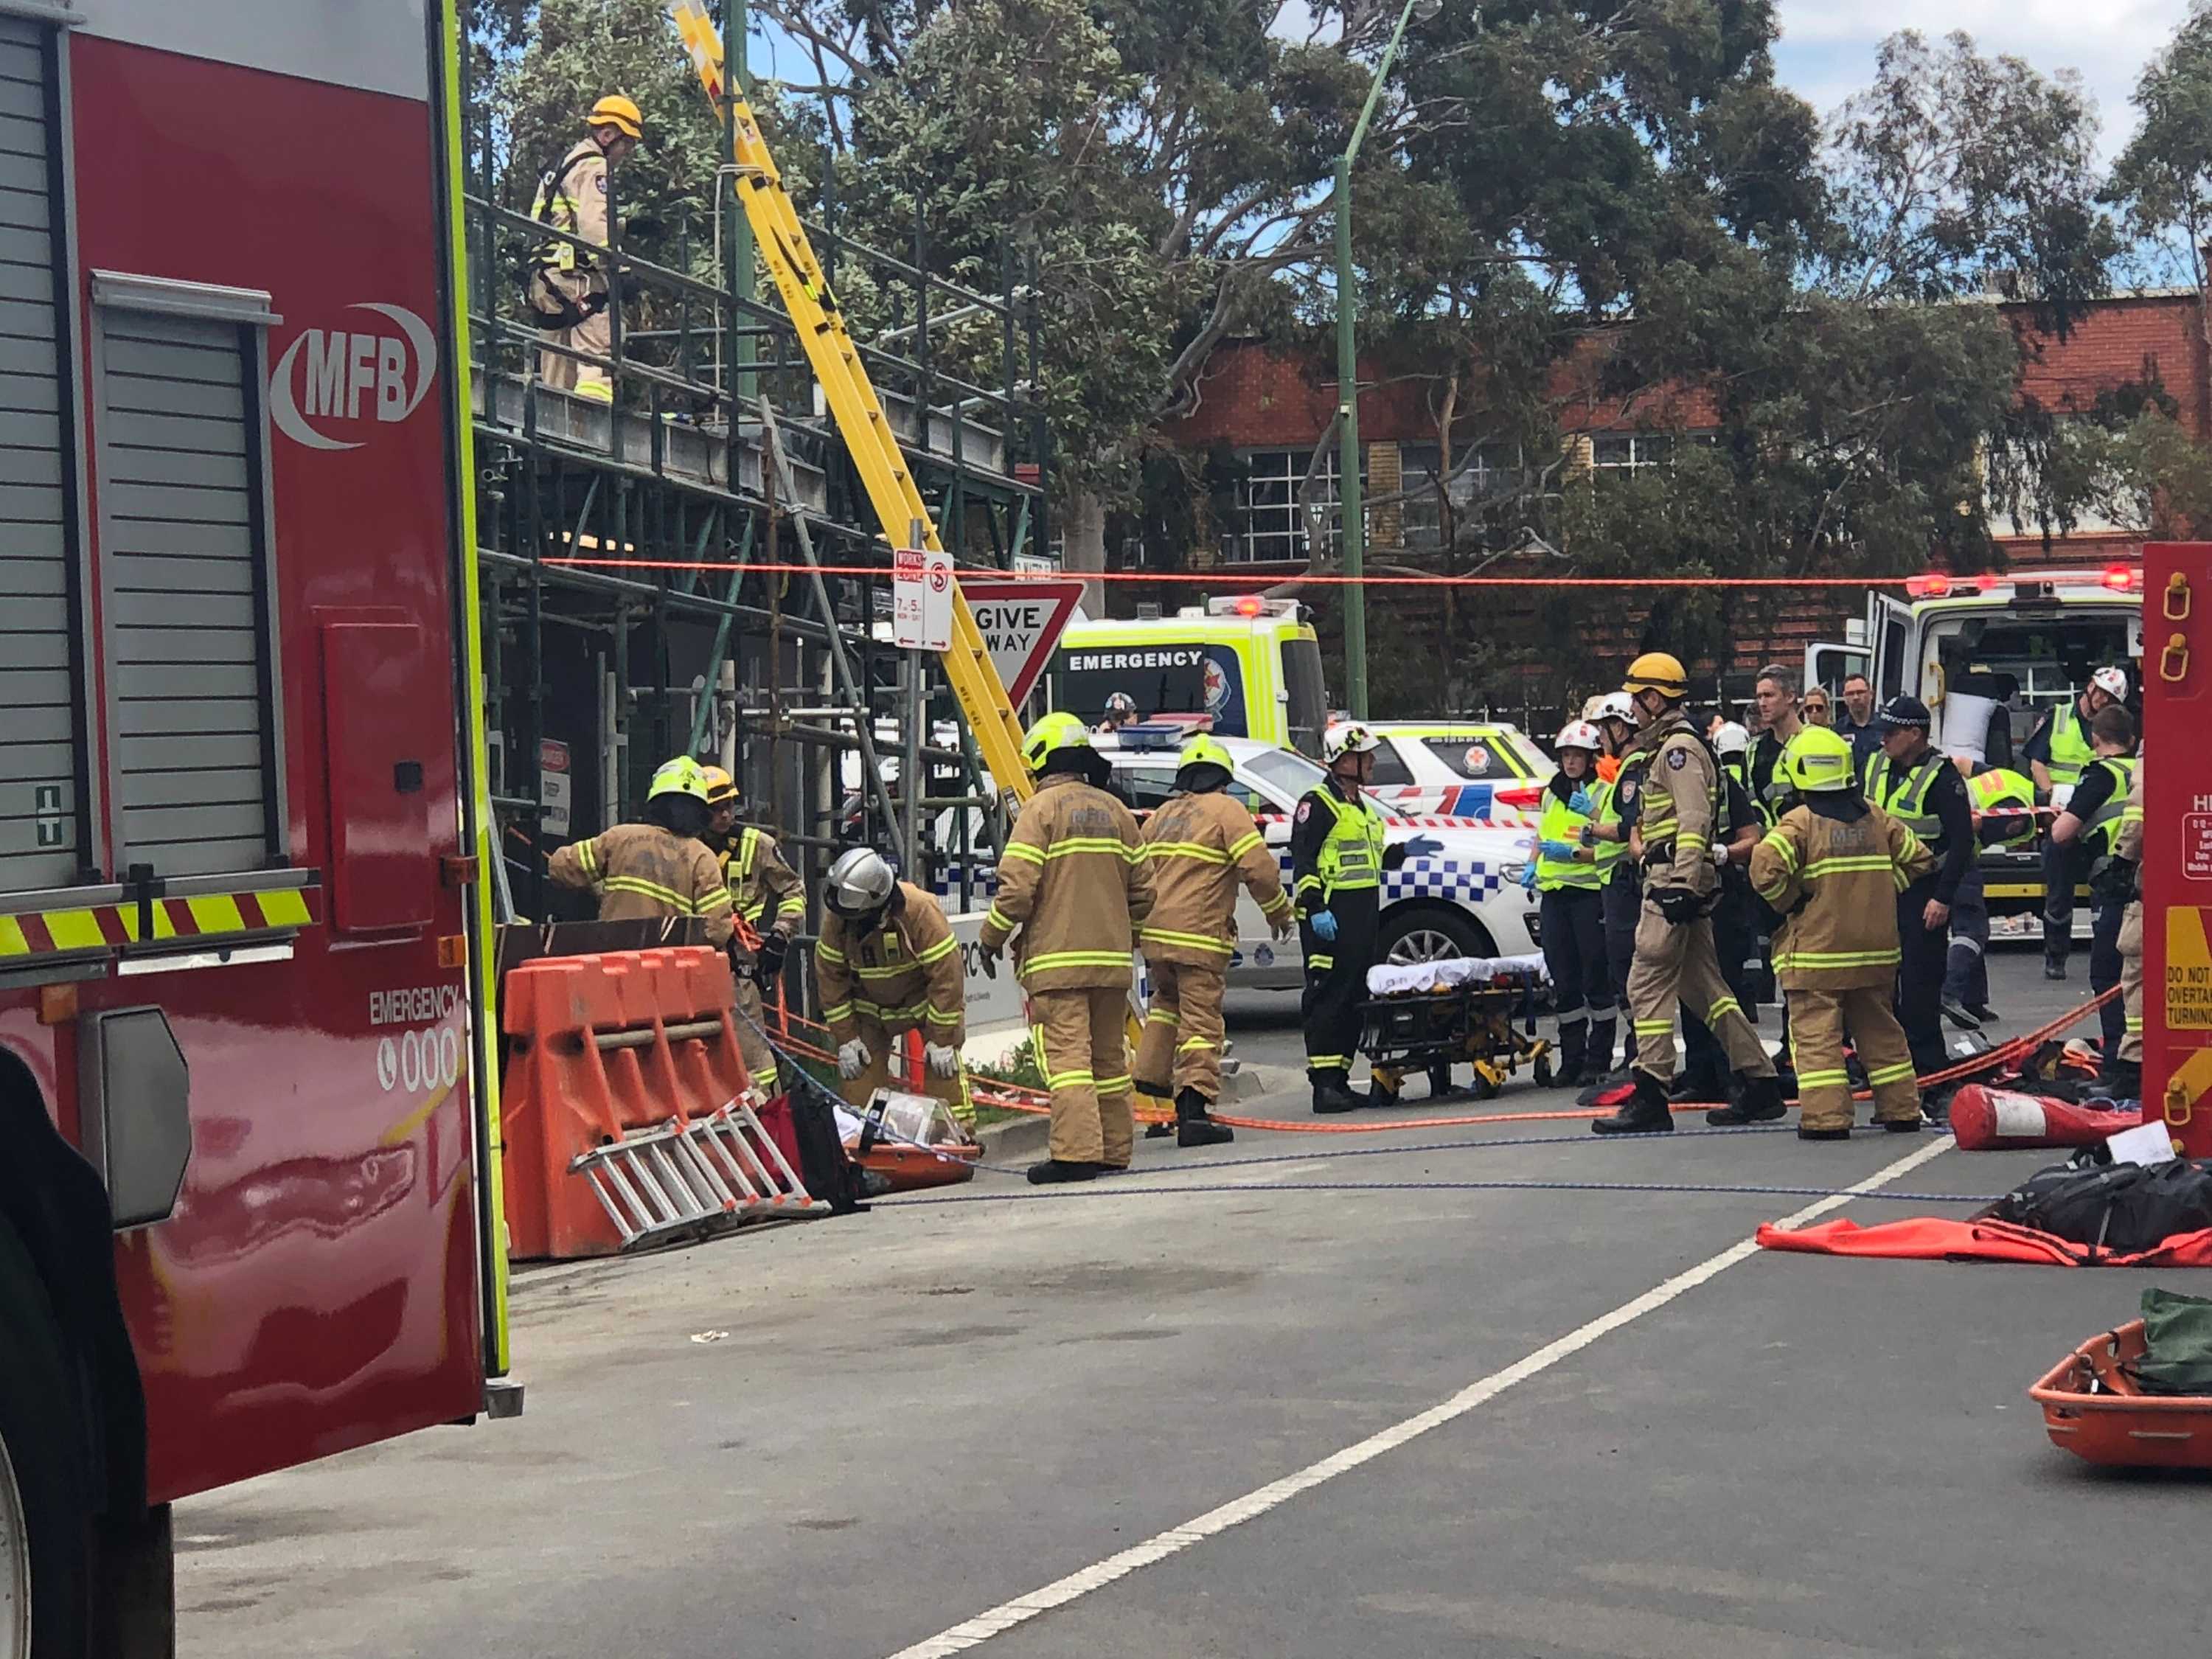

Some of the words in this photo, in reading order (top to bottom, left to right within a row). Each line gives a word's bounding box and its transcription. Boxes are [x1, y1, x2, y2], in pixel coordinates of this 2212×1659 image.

[305, 329, 407, 422] MFB
[897, 553, 922, 566] WORKS
[975, 607, 1041, 630] GIVE
[985, 633, 1032, 652] WAY
[1070, 650, 1203, 672] EMERGENCY
[2168, 966, 2183, 983] DO
[2188, 967, 2210, 983] NOT
[370, 984, 460, 1026] EMERGENCY
[402, 1027, 458, 1093] 000
